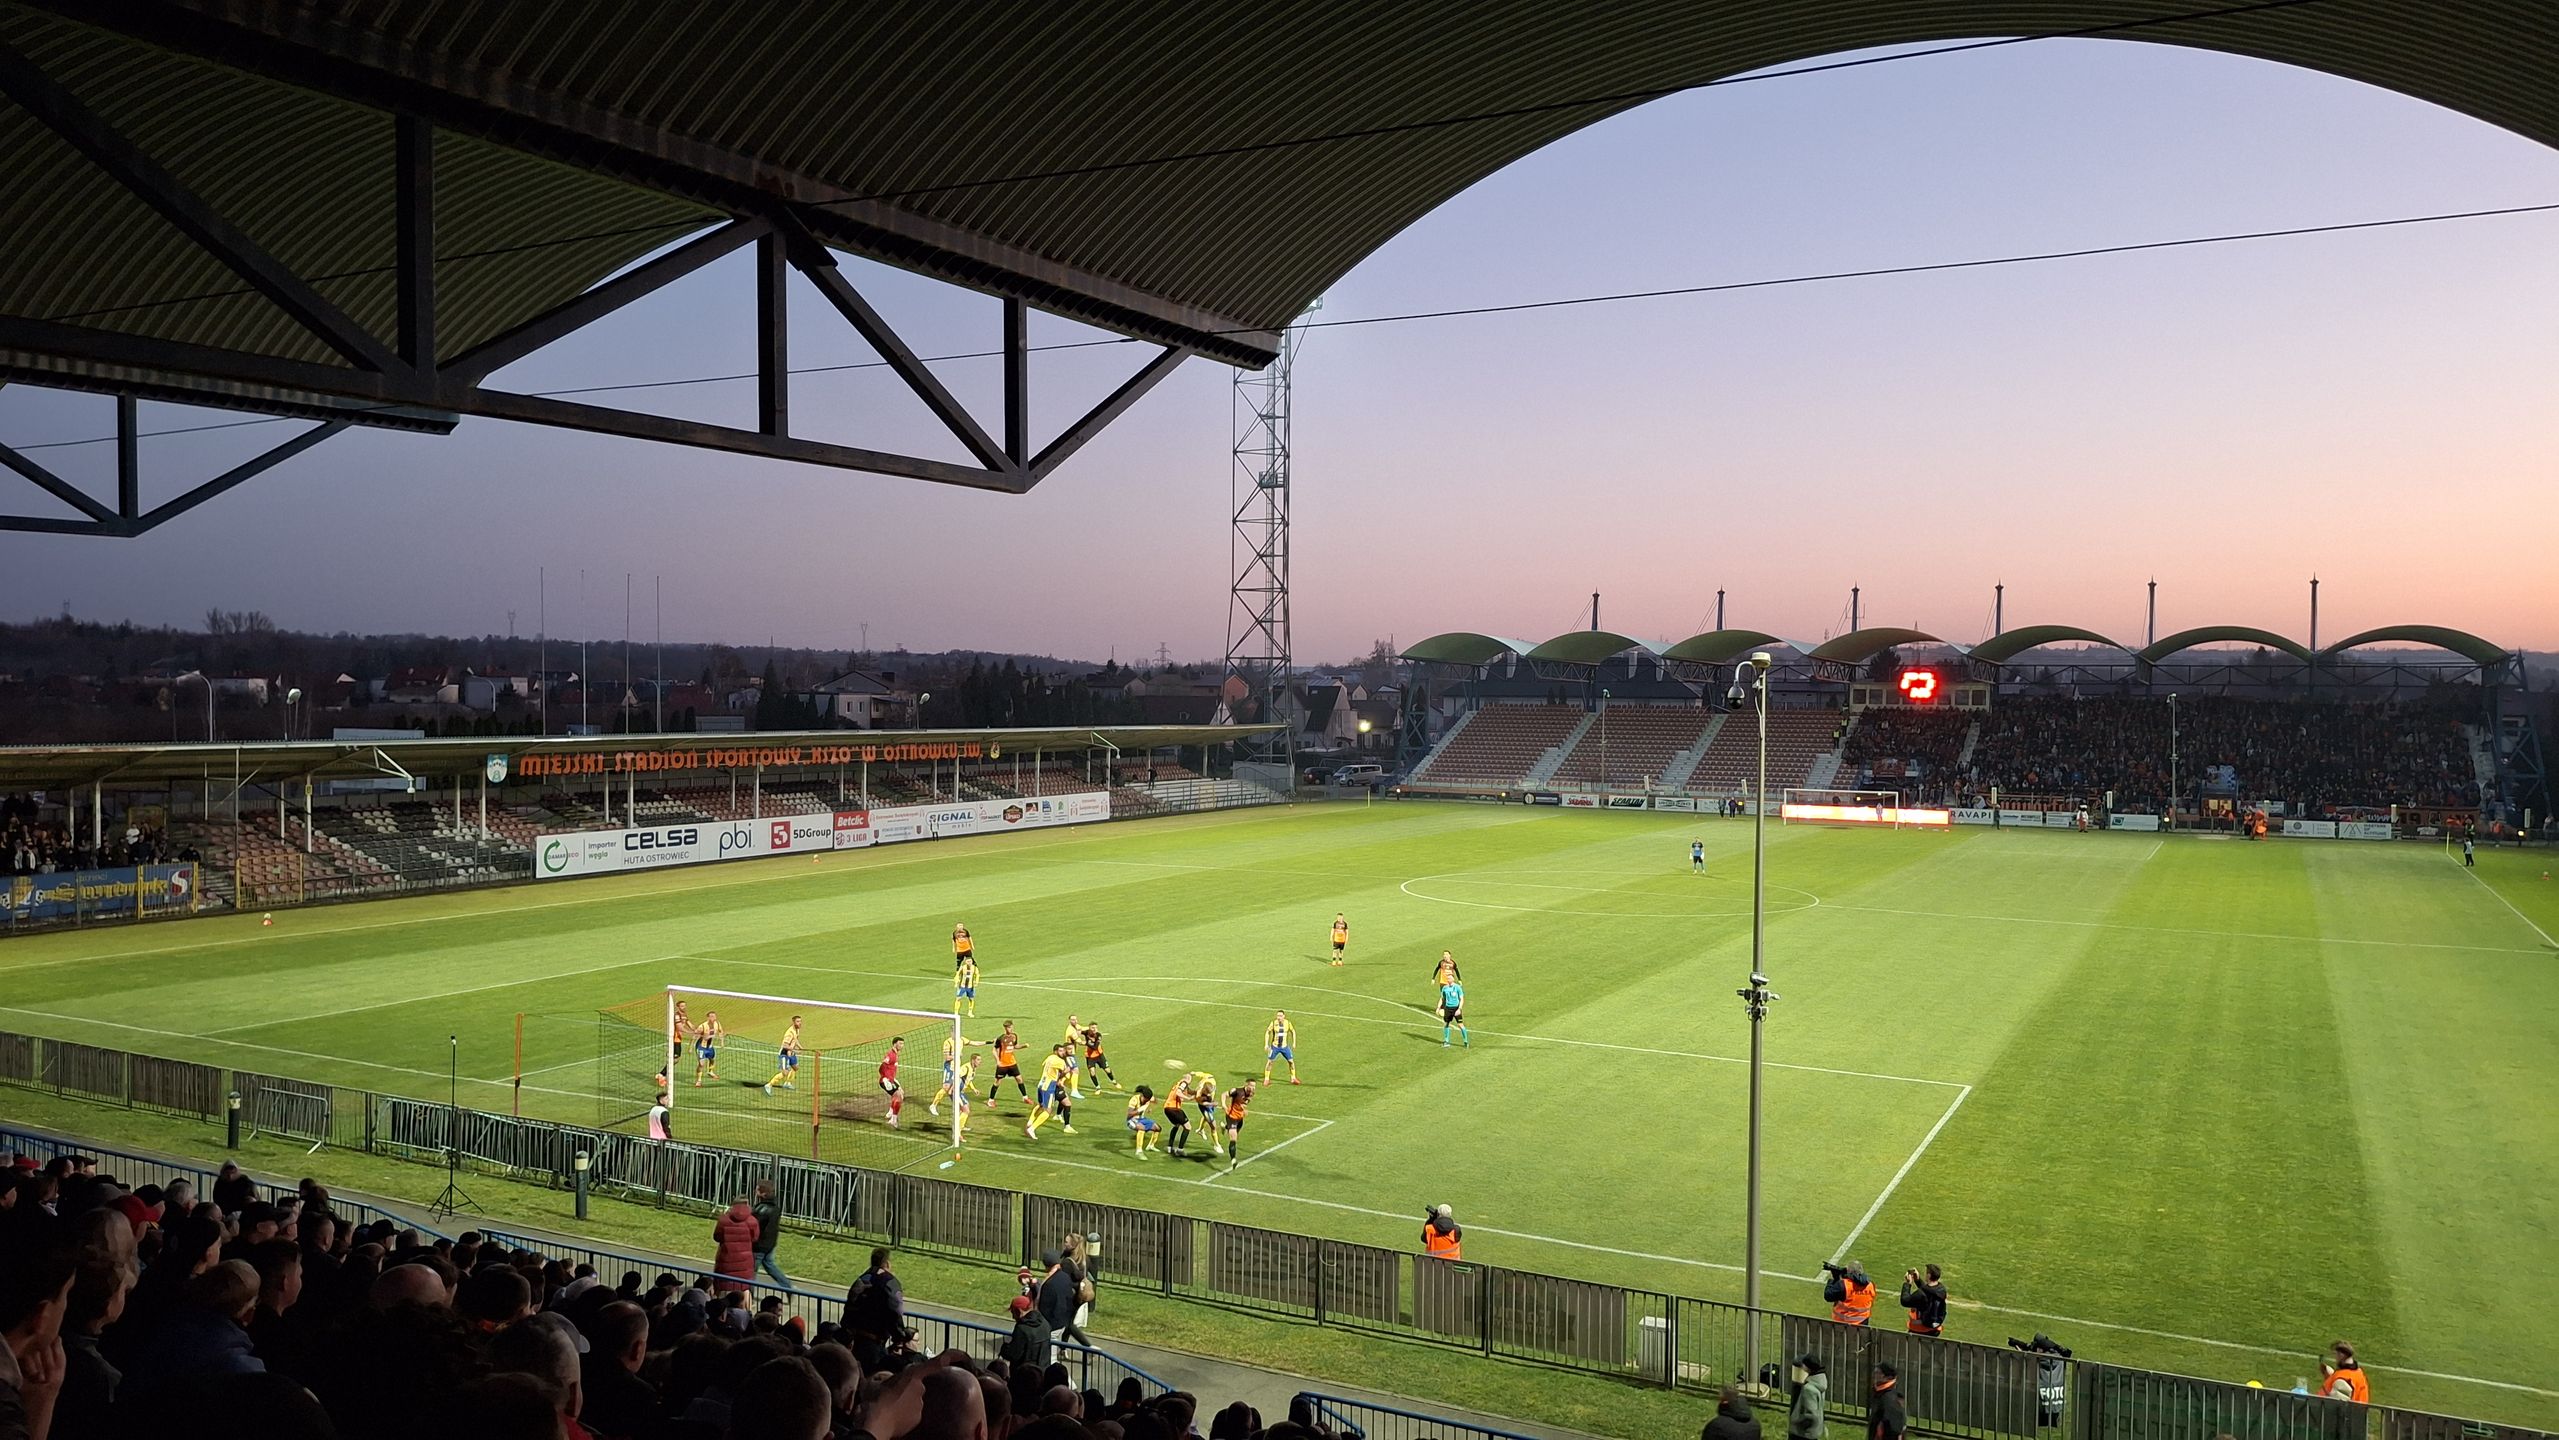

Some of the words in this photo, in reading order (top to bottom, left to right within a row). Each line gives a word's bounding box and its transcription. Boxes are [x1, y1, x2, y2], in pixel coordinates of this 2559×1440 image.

[520, 752, 604, 776] MIEJSKI
[615, 750, 698, 772] STADION
[706, 747, 800, 769] SPORTOWY
[862, 744, 876, 762] W
[884, 742, 957, 761] OSTROWCU
[837, 815, 865, 828] Betclic
[930, 811, 974, 823] SIGNAL
[793, 828, 832, 839] 5DGroup
[852, 832, 868, 842] LIGA
[623, 854, 645, 865] HUTA
[647, 851, 690, 863] OSTROWIEC
